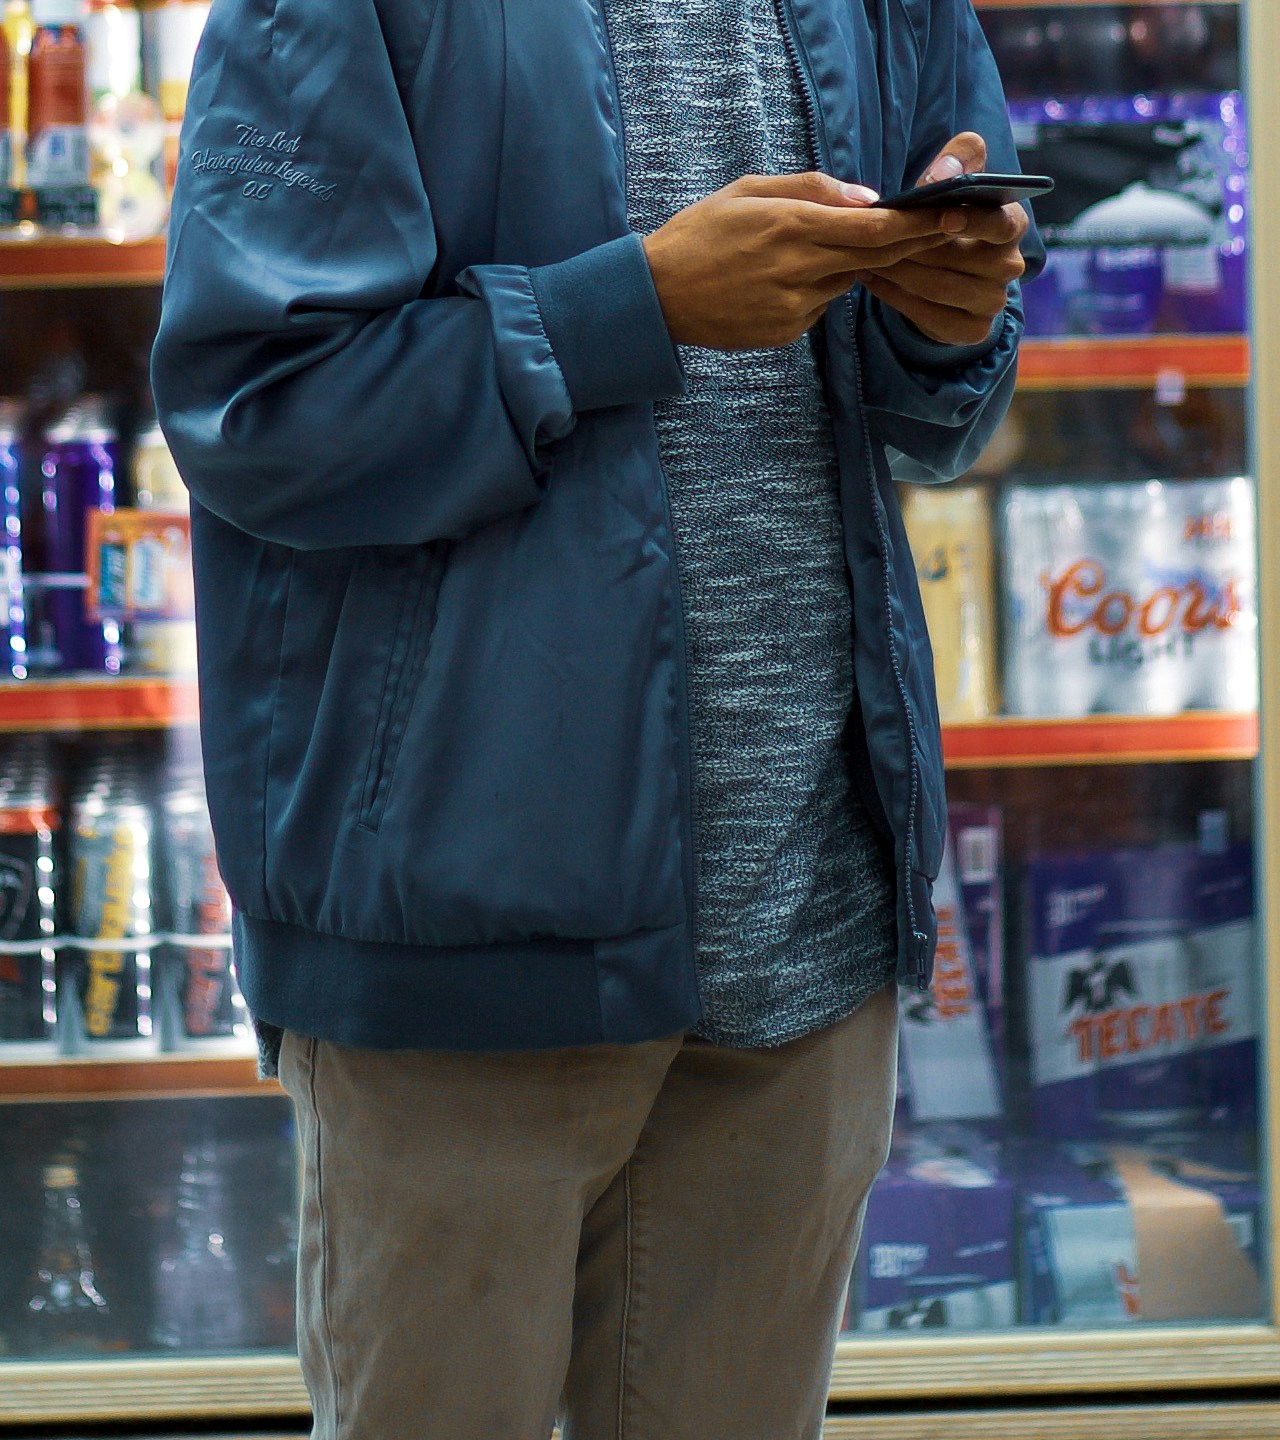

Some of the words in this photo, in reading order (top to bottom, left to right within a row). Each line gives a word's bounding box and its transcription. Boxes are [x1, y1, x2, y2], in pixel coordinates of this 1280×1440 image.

[235, 123, 266, 149] The
[267, 131, 302, 154] Lost
[191, 147, 275, 175] Harajuku
[274, 160, 338, 203] Legends
[1038, 557, 1243, 640] Coors
[1088, 632, 1197, 668] LIGHT
[1069, 987, 1231, 1064] TECATE
